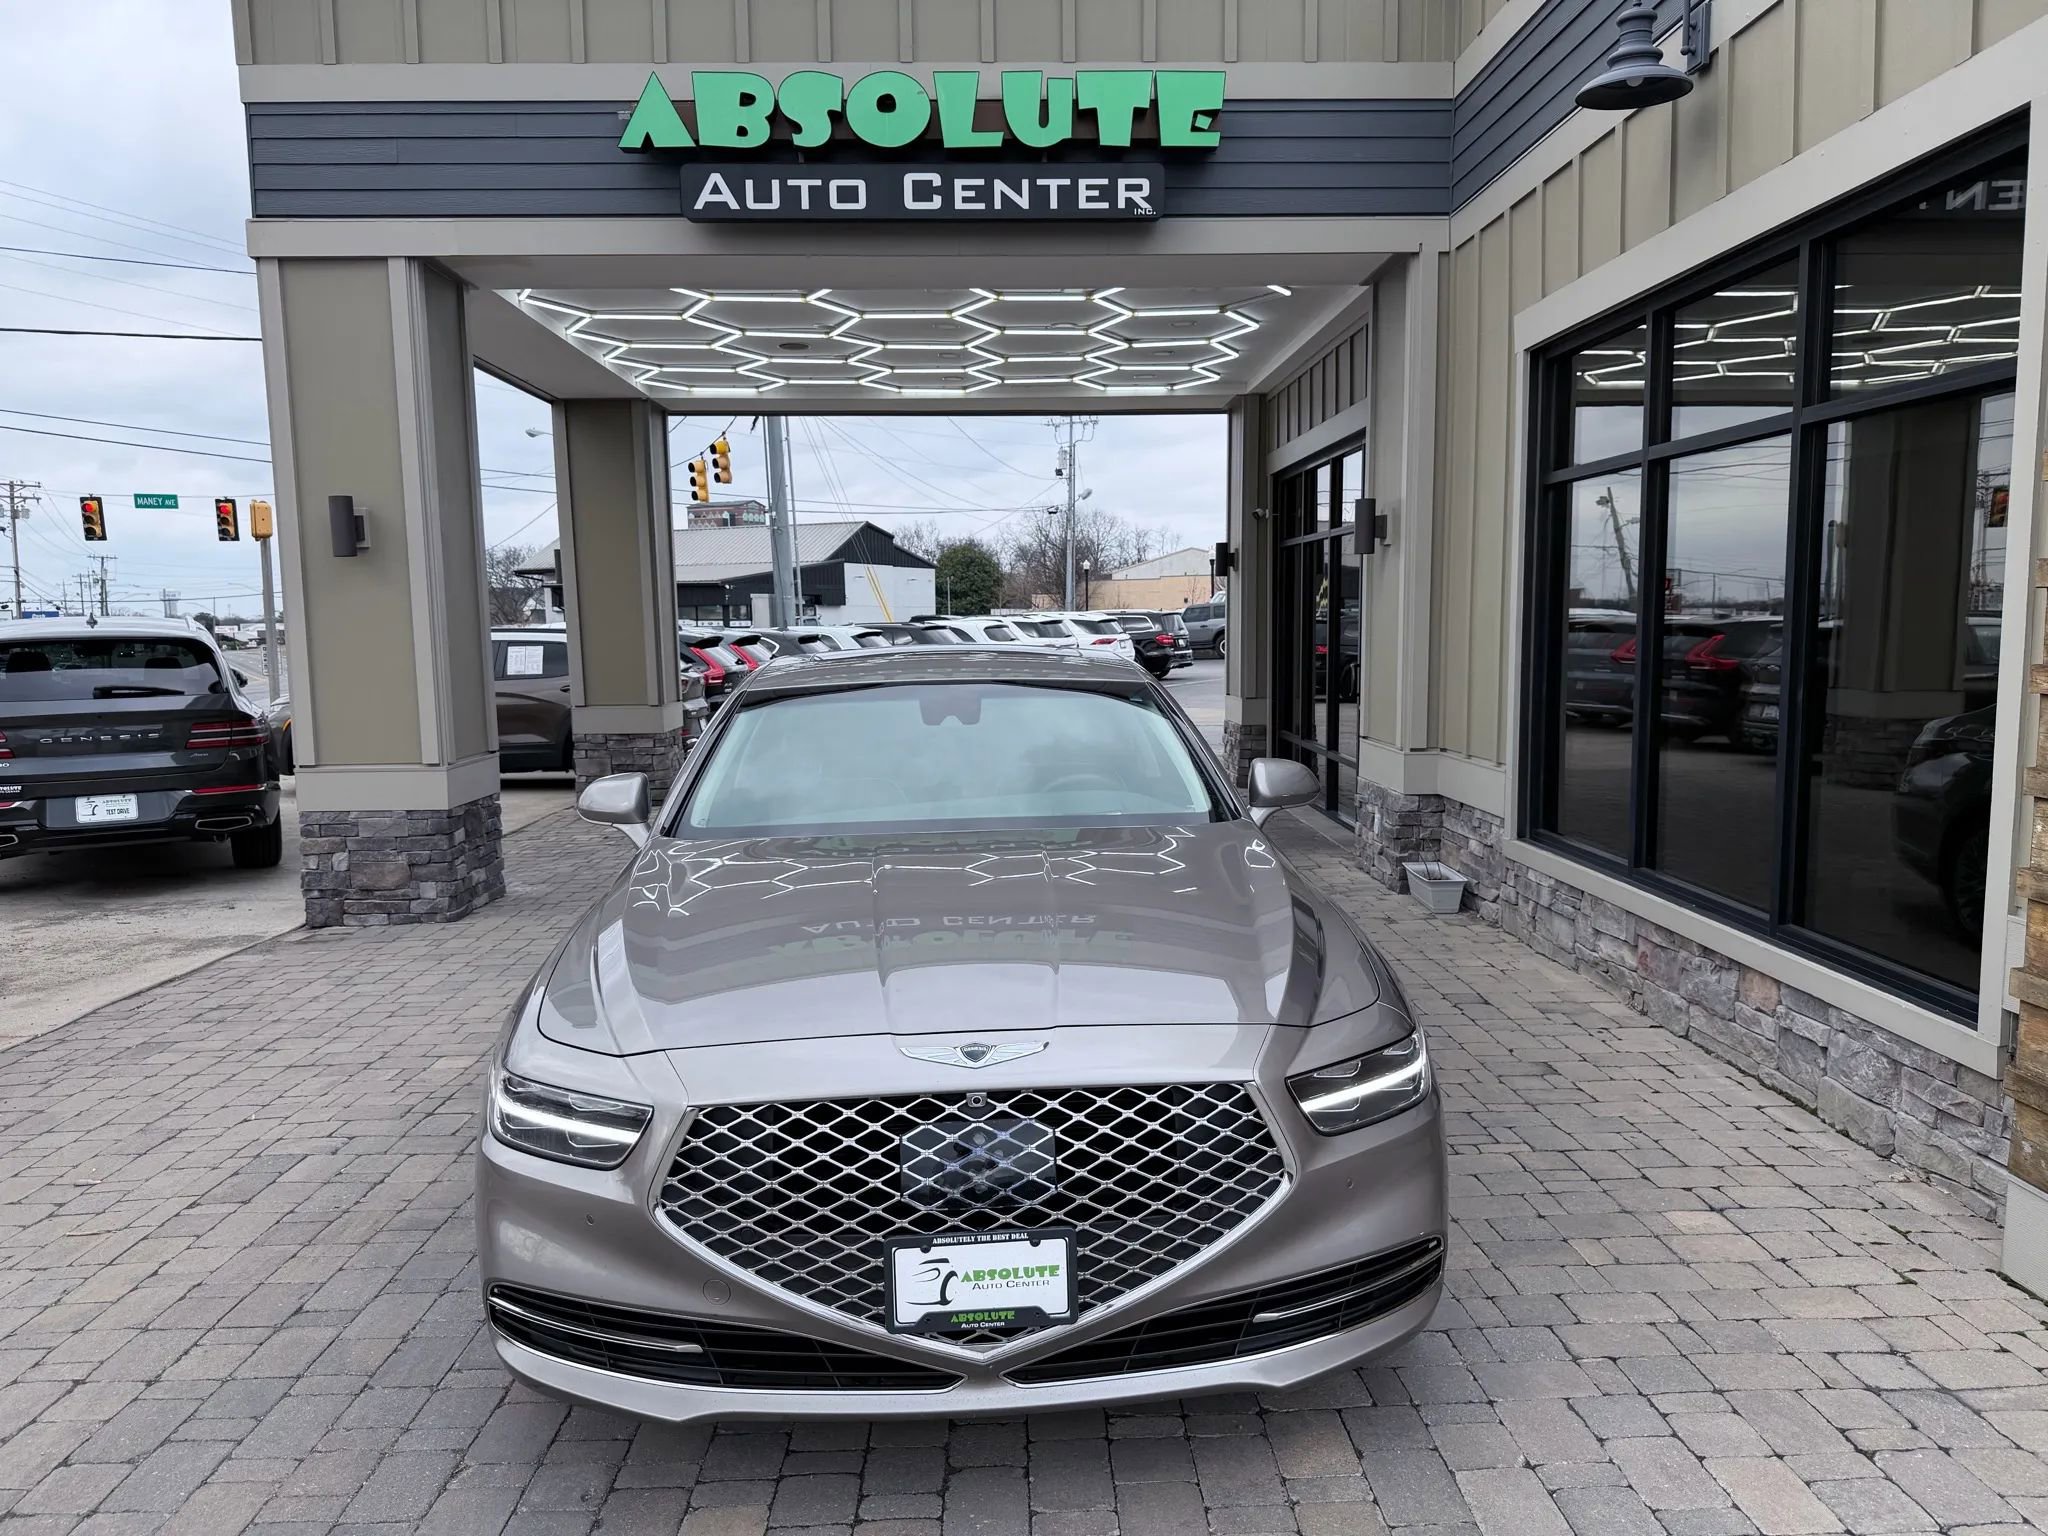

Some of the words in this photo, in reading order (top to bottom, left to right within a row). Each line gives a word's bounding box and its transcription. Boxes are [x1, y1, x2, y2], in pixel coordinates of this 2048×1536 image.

[617, 70, 1227, 151] ABSOLUTE
[693, 172, 867, 210] AUTO
[903, 172, 1152, 210] CENTER
[1133, 207, 1157, 216] INC.
[136, 496, 163, 506] MANEY
[39, 733, 160, 744] GENESIS
[116, 807, 130, 815] DRIVE
[932, 1235, 976, 1244] ABSOLUTELY
[977, 1234, 991, 1242] THE
[960, 1264, 1060, 1282] ABSOLUTE
[972, 1282, 1003, 1290] AUTO
[1006, 1279, 1050, 1288] CENTER
[950, 1310, 1015, 1323] ABSOLUTE
